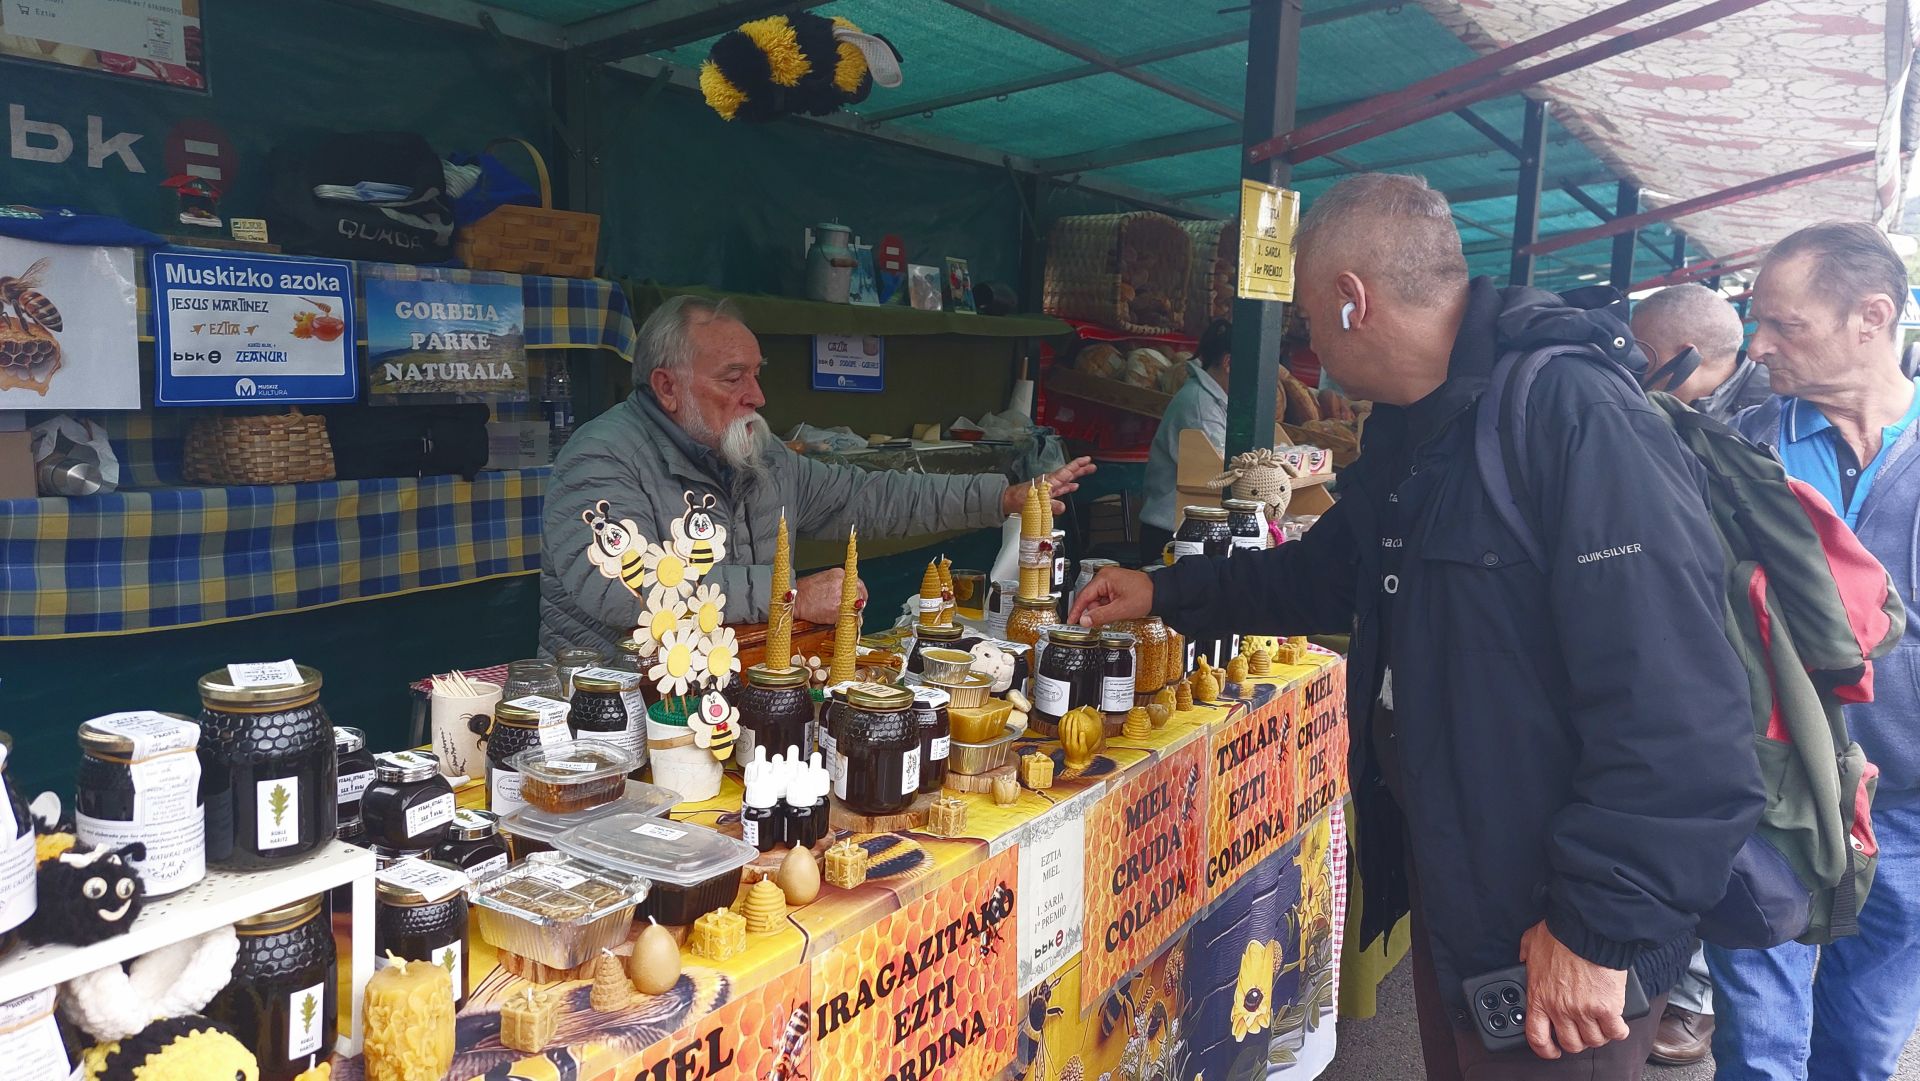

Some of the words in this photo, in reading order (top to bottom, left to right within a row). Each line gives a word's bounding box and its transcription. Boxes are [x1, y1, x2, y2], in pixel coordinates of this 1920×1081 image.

[1265, 245, 1281, 258] SARIA
[165, 262, 273, 288] Muskizko
[280, 272, 340, 292] azoka
[1263, 263, 1283, 278] PREMIO
[171, 297, 208, 312] JESUS
[212, 297, 269, 313] MARTINEZ
[395, 301, 499, 321] GORBEIA
[209, 320, 240, 335] EZTIA
[411, 332, 491, 350] PARKE
[173, 351, 205, 361] bbk
[235, 350, 287, 363] ZEANURI
[384, 362, 514, 381] NATURALA
[1577, 543, 1641, 564] QUIKSILVER
[1304, 674, 1333, 710] MIEL
[1296, 707, 1338, 751] CRUDA
[1216, 715, 1279, 776] TXILAR
[1309, 749, 1326, 781] DE
[1125, 781, 1171, 837] MIEL
[1227, 770, 1266, 822] EZTI
[1296, 777, 1337, 832] BREZO
[1040, 848, 1062, 868] EZTIA
[1111, 824, 1182, 896] CRUDA
[1205, 808, 1286, 889] GORDINA
[1042, 864, 1061, 883] MIEL
[1044, 892, 1064, 913] SARIA
[1104, 873, 1187, 953] COLADA
[1041, 904, 1067, 930] PREMIO
[1034, 938, 1055, 960] bbk
[816, 886, 1015, 1042] IRAGAZITAKO
[893, 975, 956, 1046] EZTI
